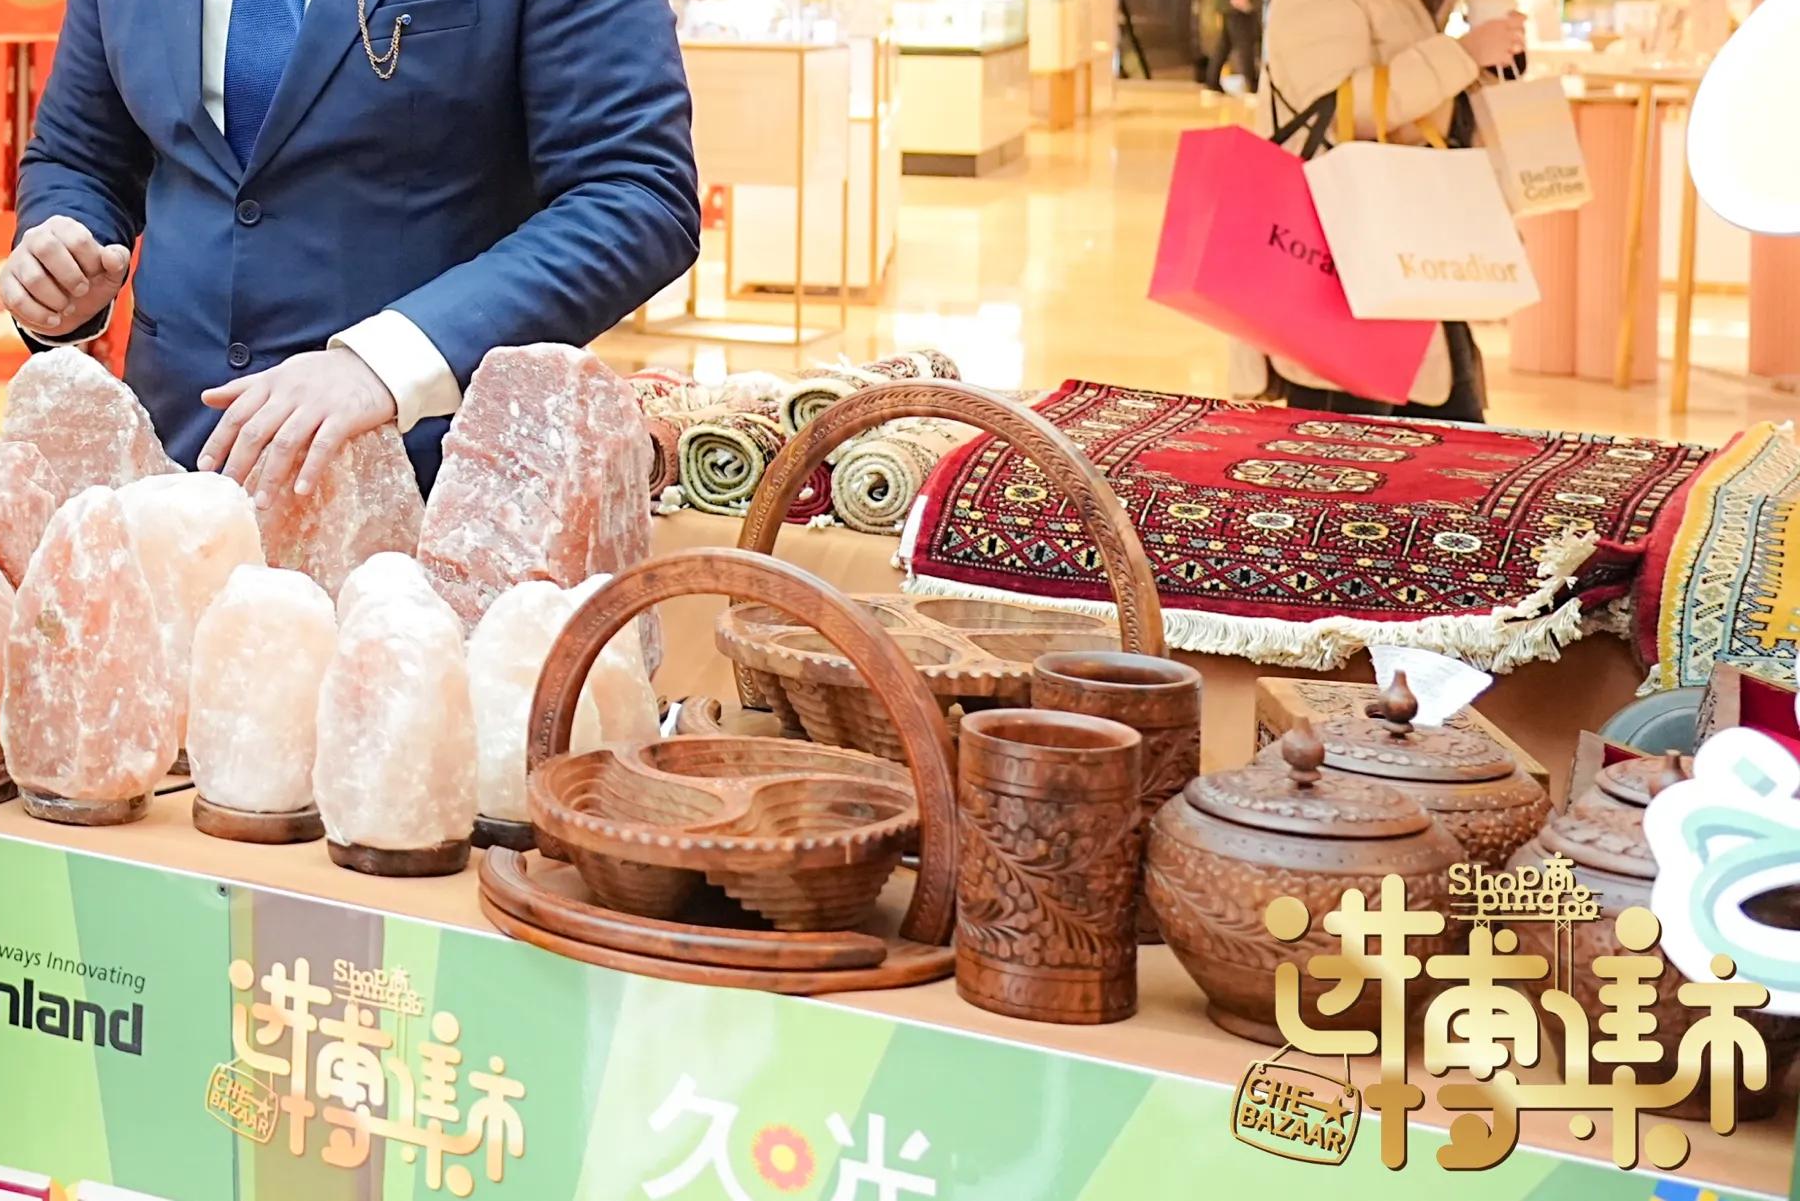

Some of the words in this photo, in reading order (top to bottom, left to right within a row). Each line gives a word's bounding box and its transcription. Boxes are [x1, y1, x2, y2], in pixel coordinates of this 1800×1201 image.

[1397, 252, 1518, 284] Koradior
[46, 951, 146, 994] Innovating
[209, 1090, 270, 1137] BAZAAR
